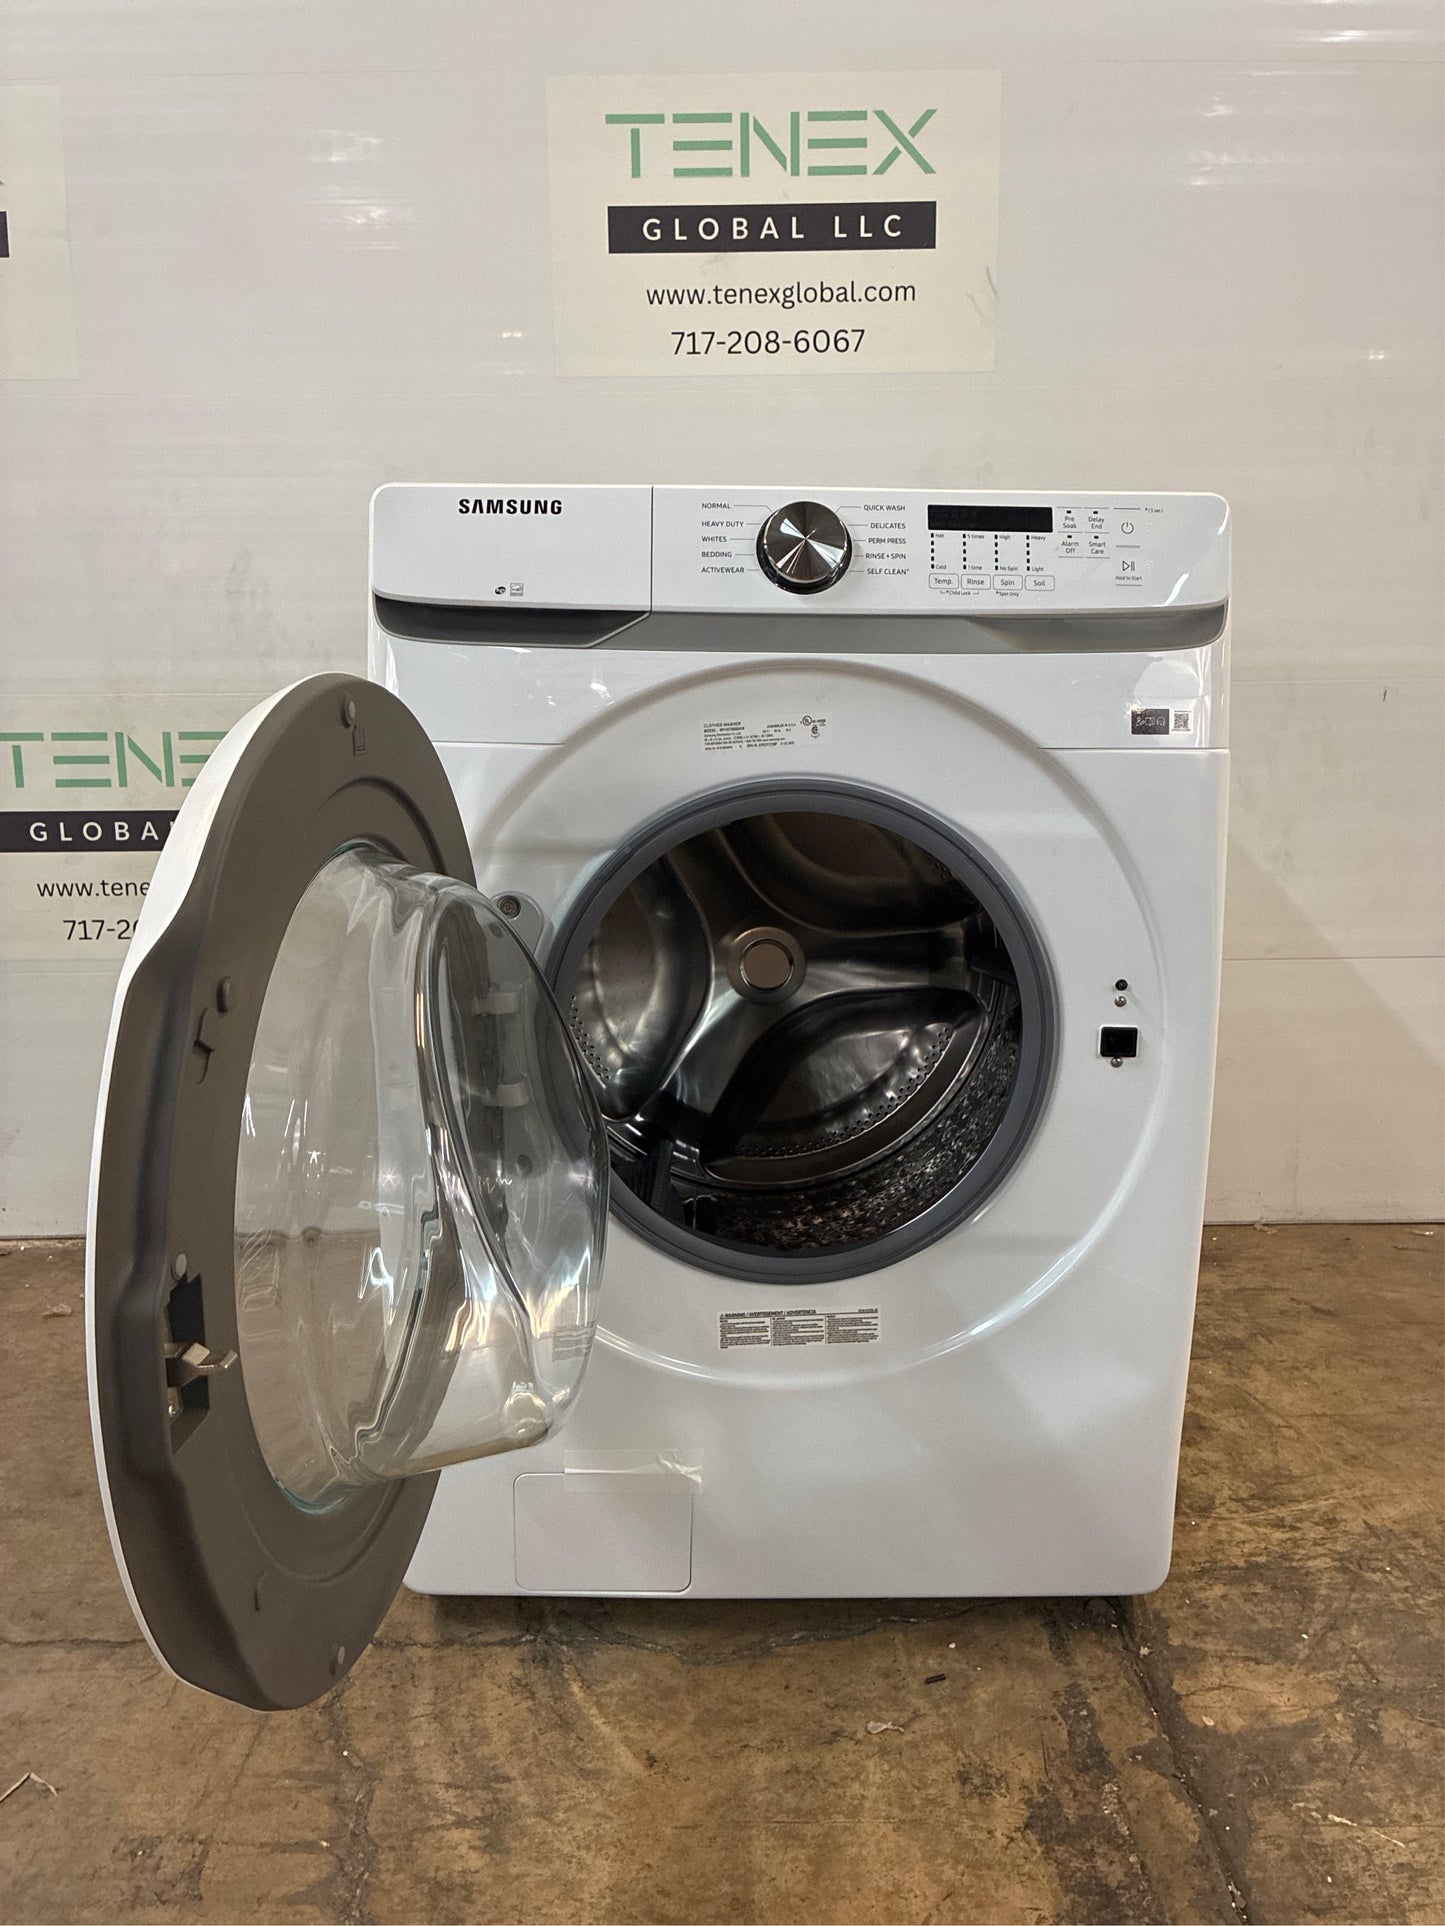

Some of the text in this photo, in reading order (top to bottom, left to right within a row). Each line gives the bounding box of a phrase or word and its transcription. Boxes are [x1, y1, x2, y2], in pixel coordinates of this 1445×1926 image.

[605, 109, 938, 179] TENEX
[642, 214, 902, 241] GLOBAL LLC
[646, 281, 916, 309] www.tenexglobal.com
[671, 329, 865, 355] 717-208-6067
[458, 499, 562, 515] SAMSUNG
[701, 502, 731, 510] NORMAL
[1088, 516, 1105, 524] Delay
[701, 535, 727, 543] WHITES
[865, 552, 884, 560] RINSE
[701, 566, 745, 574] ACTIVEWEAR
[866, 567, 883, 575] SELF
[934, 577, 953, 586] Temp.
[967, 578, 985, 586] Rinse
[1000, 579, 1014, 587] Spin
[1033, 579, 1046, 587] Soil
[30, 821, 175, 842] GLOBA
